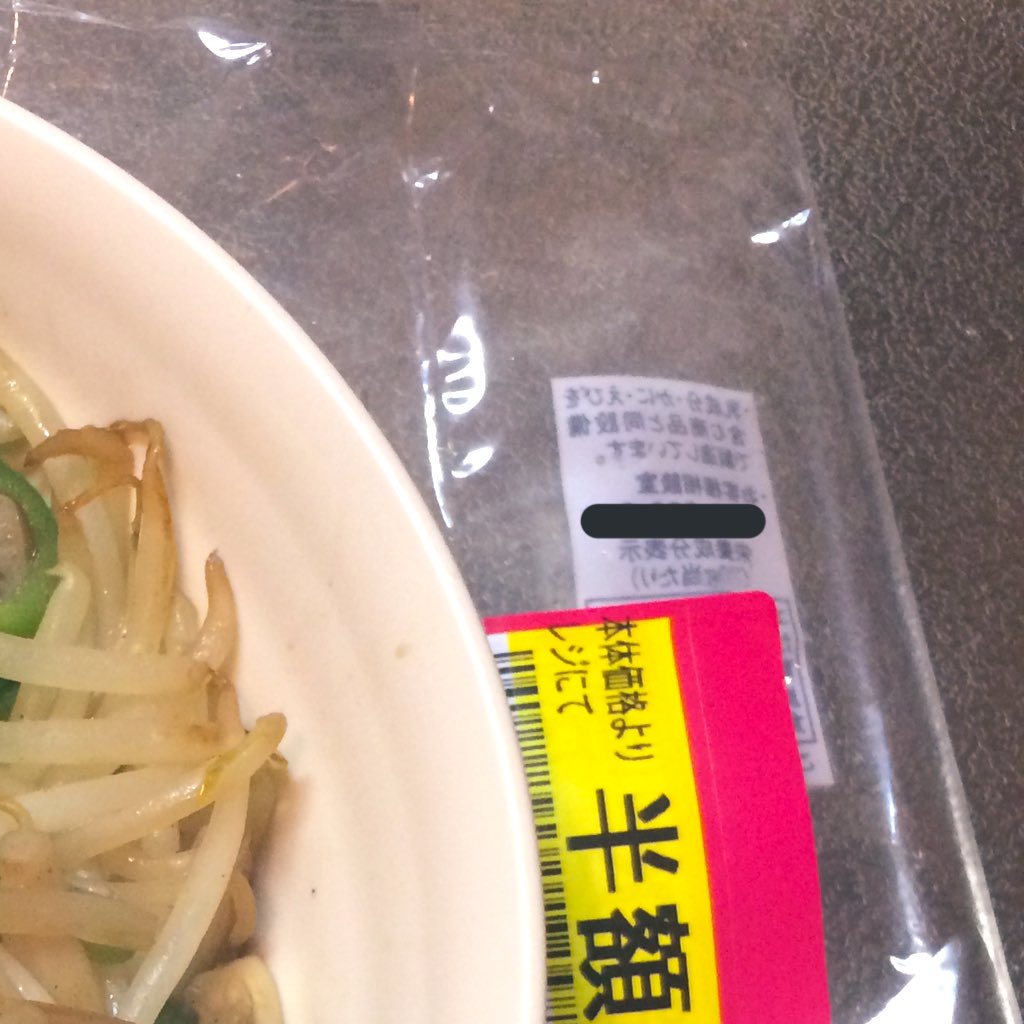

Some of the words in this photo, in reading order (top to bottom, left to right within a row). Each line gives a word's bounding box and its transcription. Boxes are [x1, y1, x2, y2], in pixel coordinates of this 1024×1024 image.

[549, 622, 594, 714] レジにて
[596, 616, 654, 761] 本体価格より
[566, 788, 691, 1021] 半額
